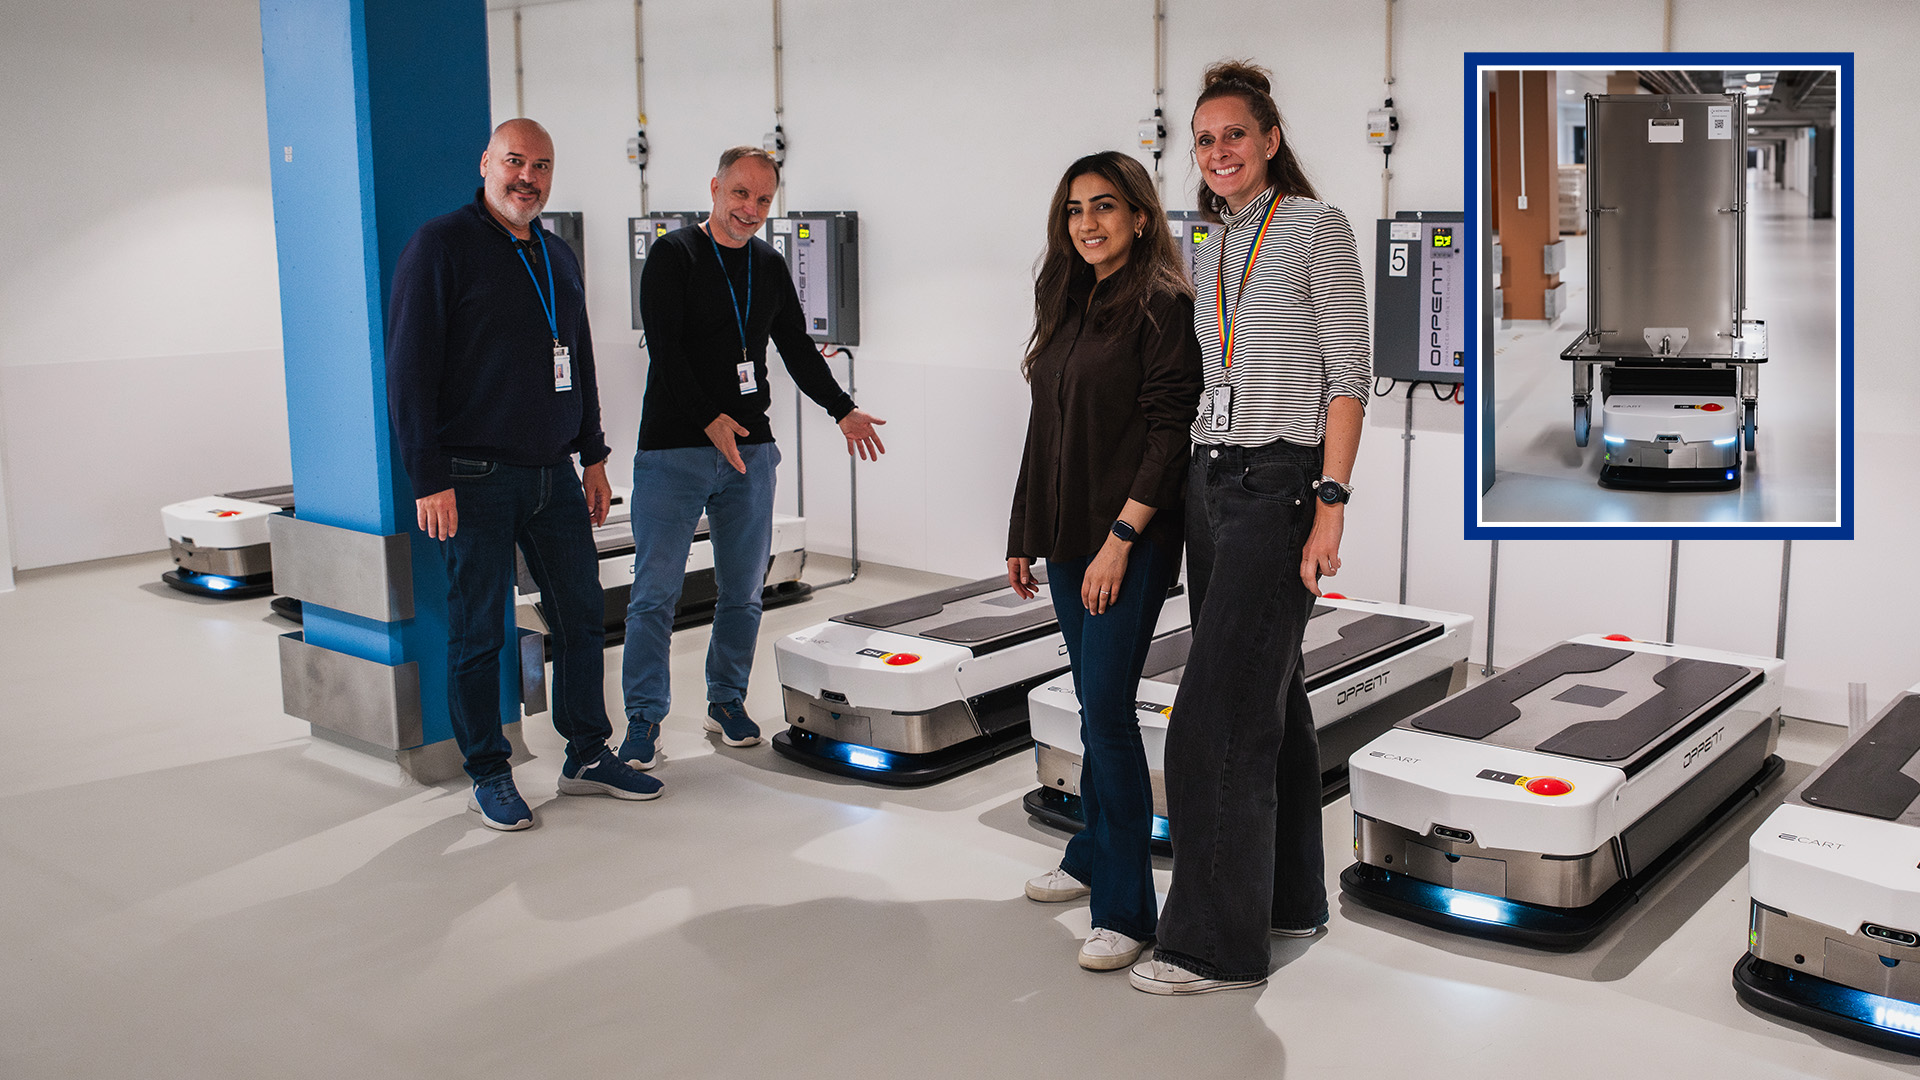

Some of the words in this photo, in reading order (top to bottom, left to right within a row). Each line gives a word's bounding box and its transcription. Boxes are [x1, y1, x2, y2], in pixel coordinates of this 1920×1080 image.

[637, 238, 644, 255] 2
[1392, 248, 1406, 271] 5
[1430, 261, 1443, 366] OPPENT
[1336, 670, 1390, 705] OPPENT
[1683, 726, 1724, 768] OPPENT
